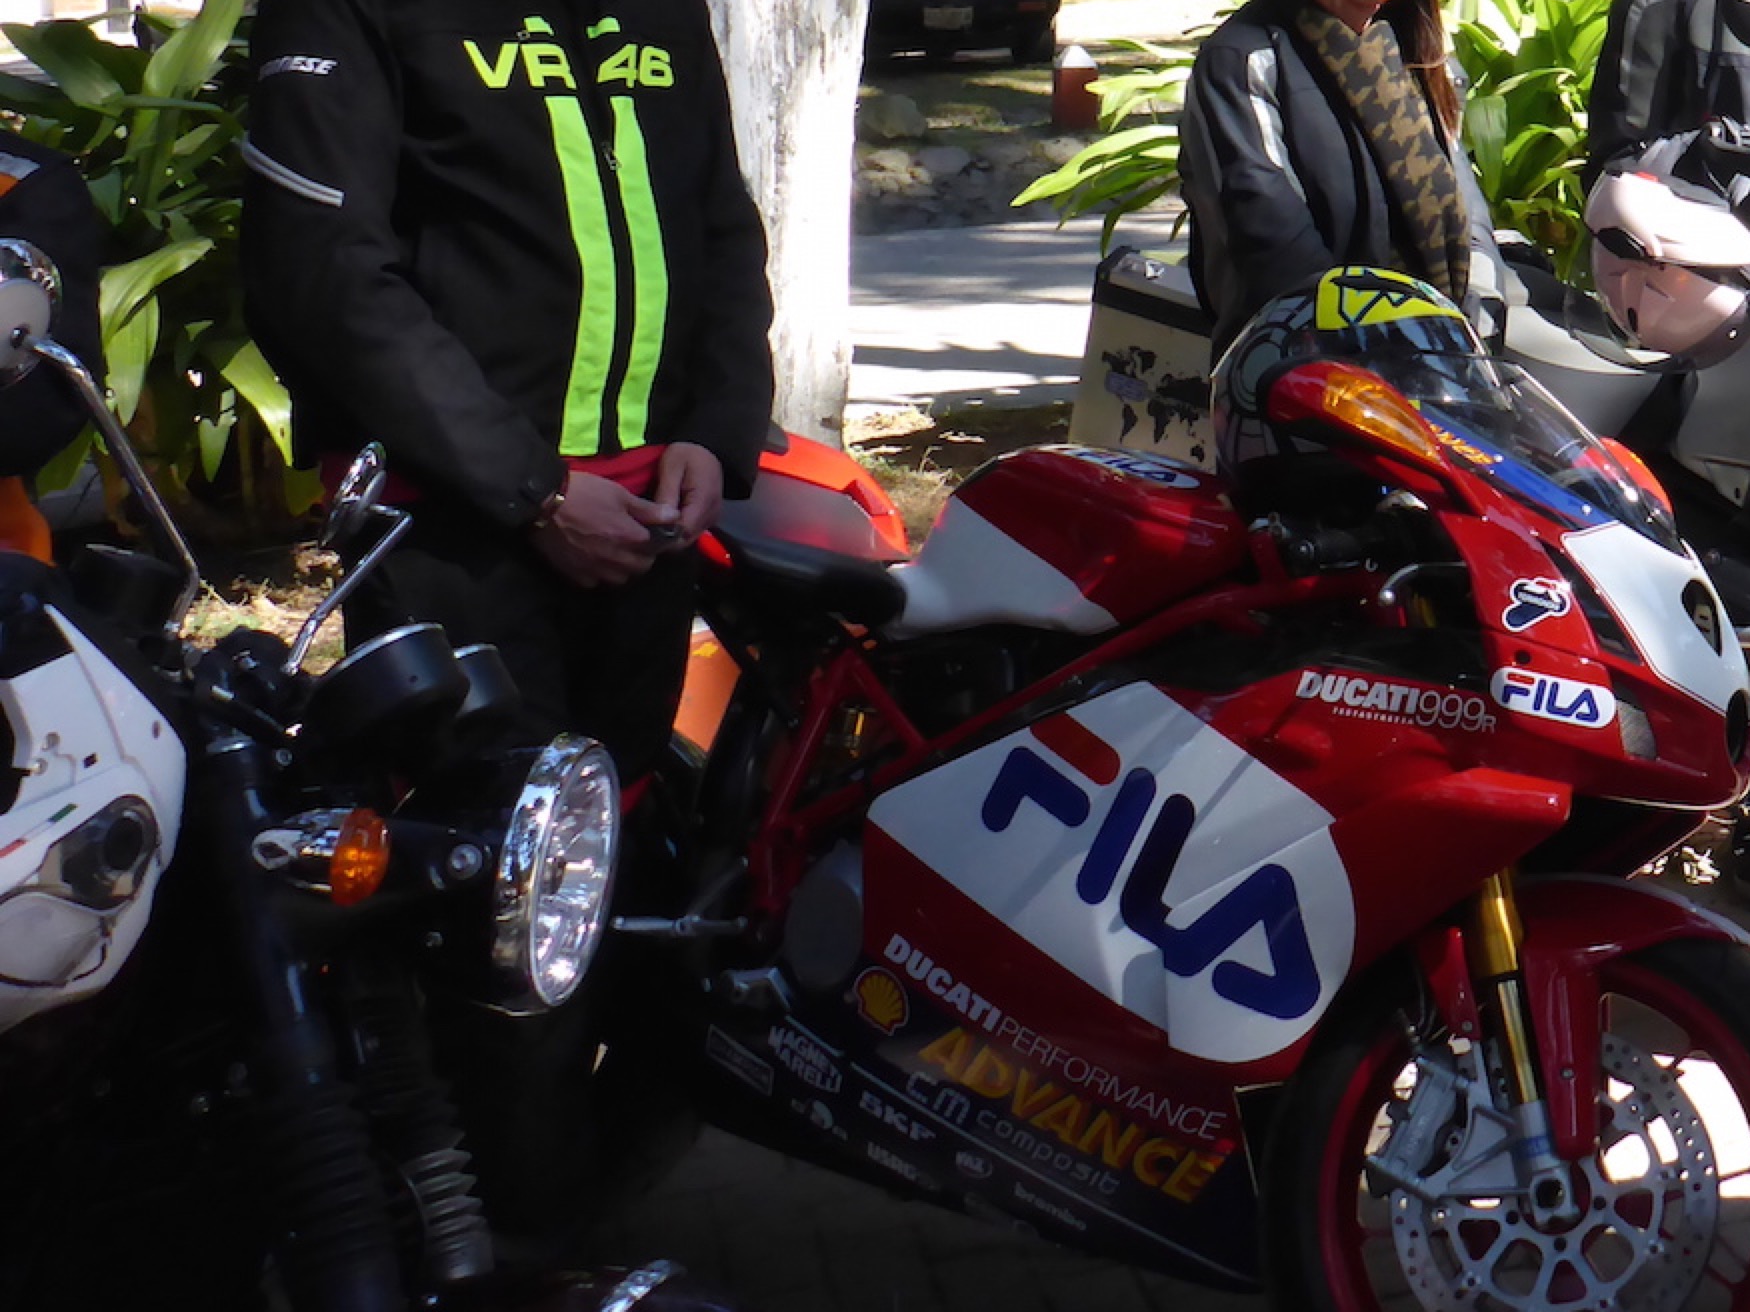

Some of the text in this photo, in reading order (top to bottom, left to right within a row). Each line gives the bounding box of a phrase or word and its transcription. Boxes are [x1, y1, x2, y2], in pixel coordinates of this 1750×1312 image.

[463, 40, 675, 88] VR 46
[1296, 669, 1420, 715] DUCATI
[1501, 674, 1600, 722] FILA
[982, 712, 1321, 1020] FILA
[883, 934, 1226, 1141] DUCATI PERFORMANCE
[917, 1026, 1237, 1204] ADVANCE
